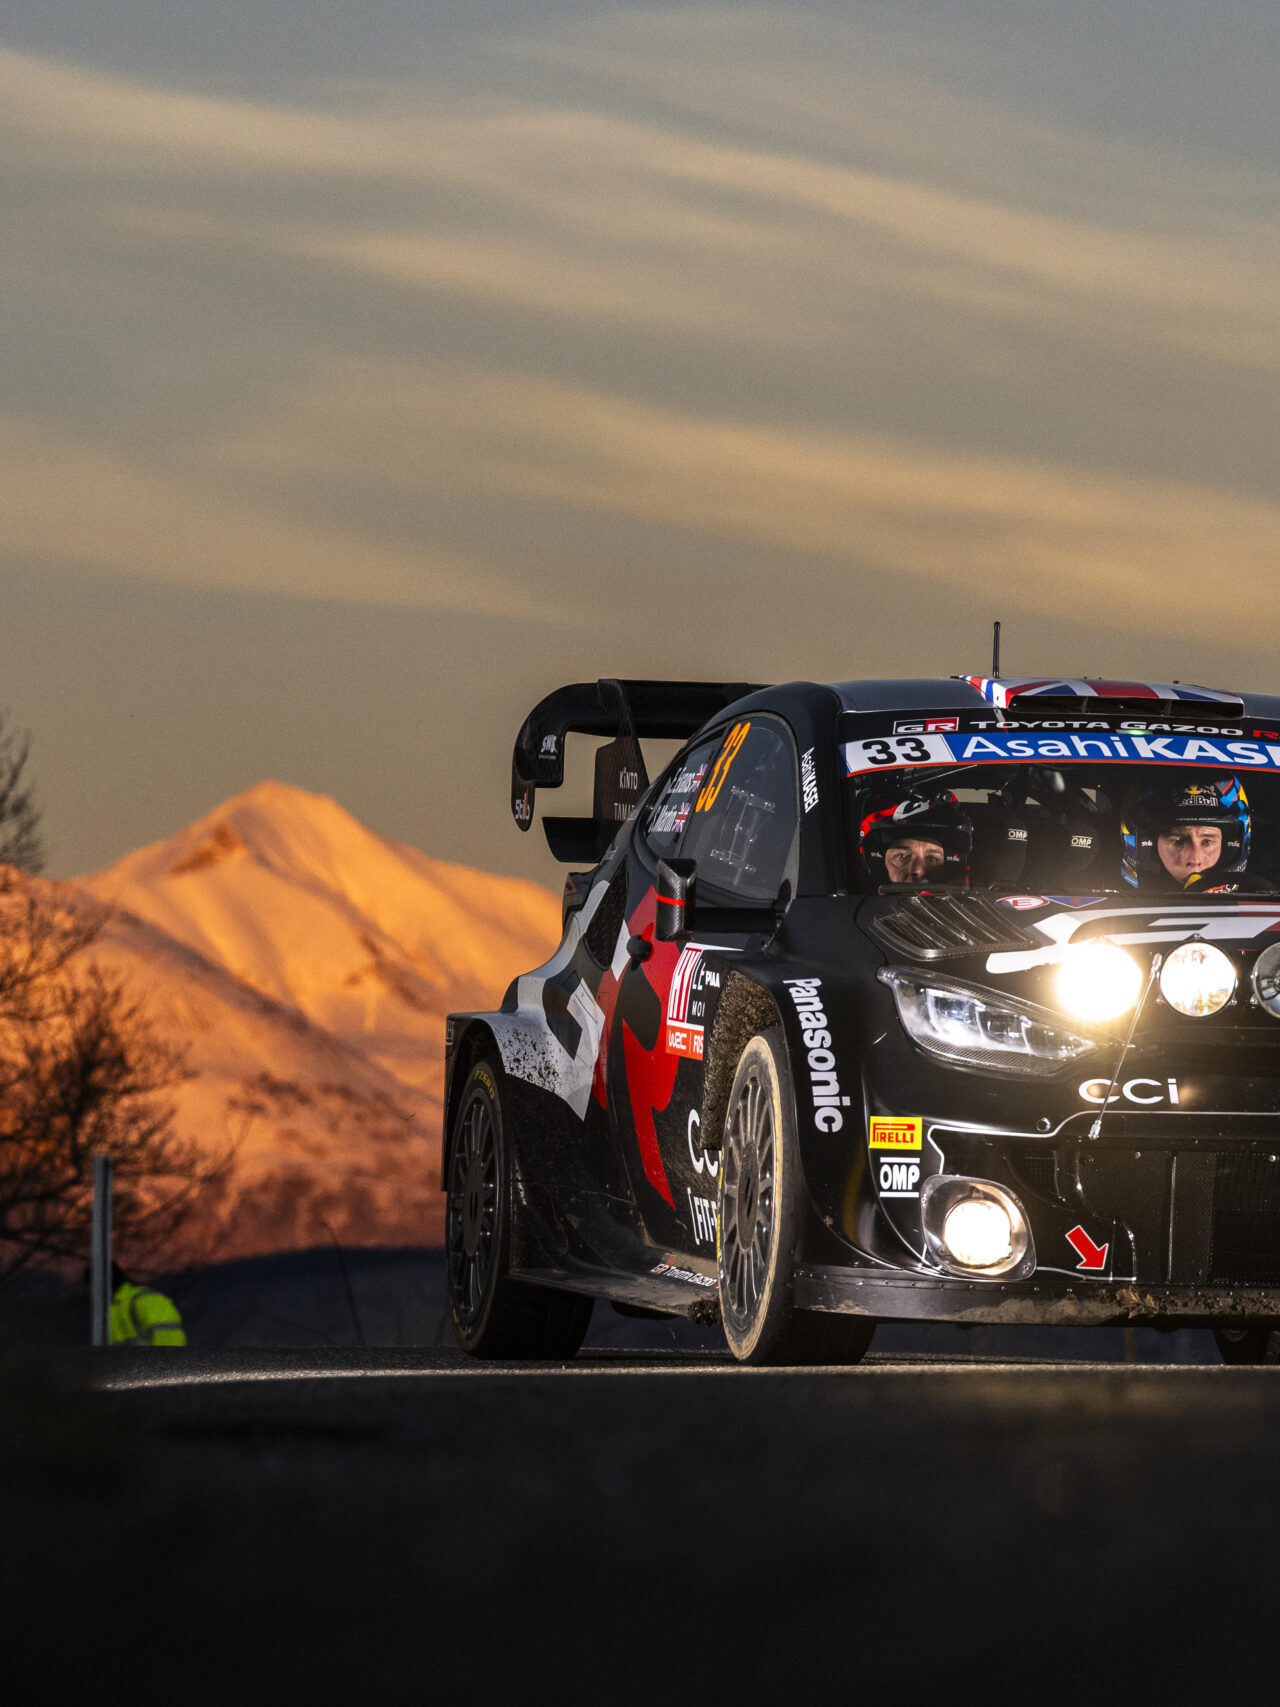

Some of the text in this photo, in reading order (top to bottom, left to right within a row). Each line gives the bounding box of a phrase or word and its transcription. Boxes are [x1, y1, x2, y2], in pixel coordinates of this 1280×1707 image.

[895, 719, 958, 734] GR
[970, 721, 1111, 729] TOYOTA
[1120, 721, 1243, 736] GAZOO
[862, 738, 931, 765] 33
[696, 722, 750, 812] 33
[1008, 830, 1028, 840] OMP
[1071, 836, 1092, 847] OMP
[783, 978, 850, 1132] Panasonic
[873, 1123, 915, 1144] PIRELLI
[880, 1164, 920, 1190] OMP
